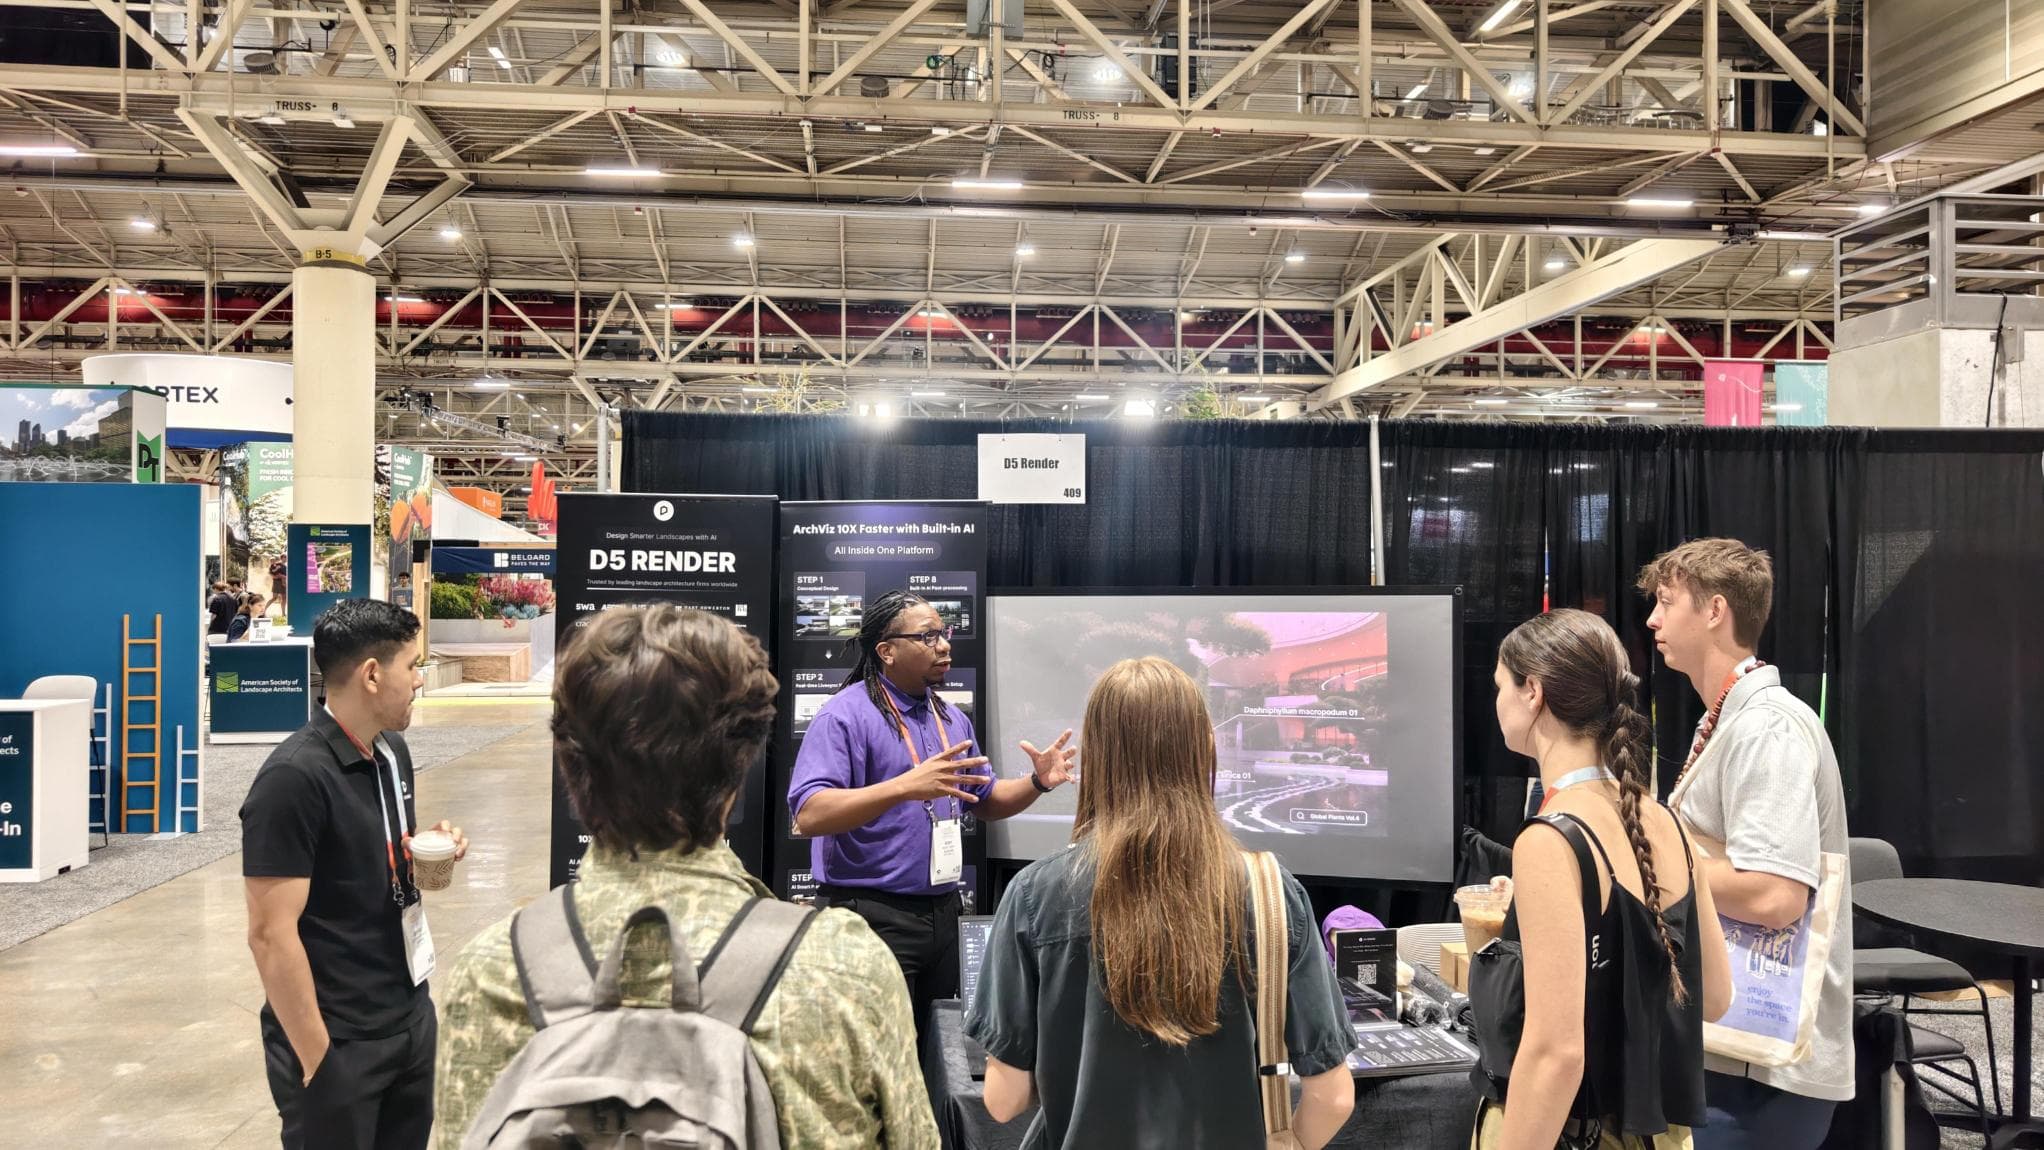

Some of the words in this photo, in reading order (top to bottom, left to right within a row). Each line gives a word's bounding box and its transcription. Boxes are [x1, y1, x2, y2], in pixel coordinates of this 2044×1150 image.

[1004, 458, 1018, 469] D5
[1021, 458, 1059, 469] Render
[1063, 488, 1081, 498] 409
[793, 525, 835, 534] ArchViz
[837, 525, 857, 534] 10X
[859, 524, 893, 534] Faster
[894, 524, 919, 534] with
[922, 523, 961, 533] Built-in
[963, 524, 975, 533] AI
[606, 532, 628, 540] Design
[834, 546, 846, 555] All
[848, 546, 875, 555] Inside
[877, 546, 895, 555] One
[897, 546, 934, 555] Platform
[590, 549, 626, 571] D5
[632, 550, 736, 572] RENDER
[797, 576, 818, 584] STEP
[910, 575, 930, 583] STEP
[796, 673, 816, 681] STEP
[818, 673, 823, 681] 2
[1299, 708, 1348, 717] macropodum
